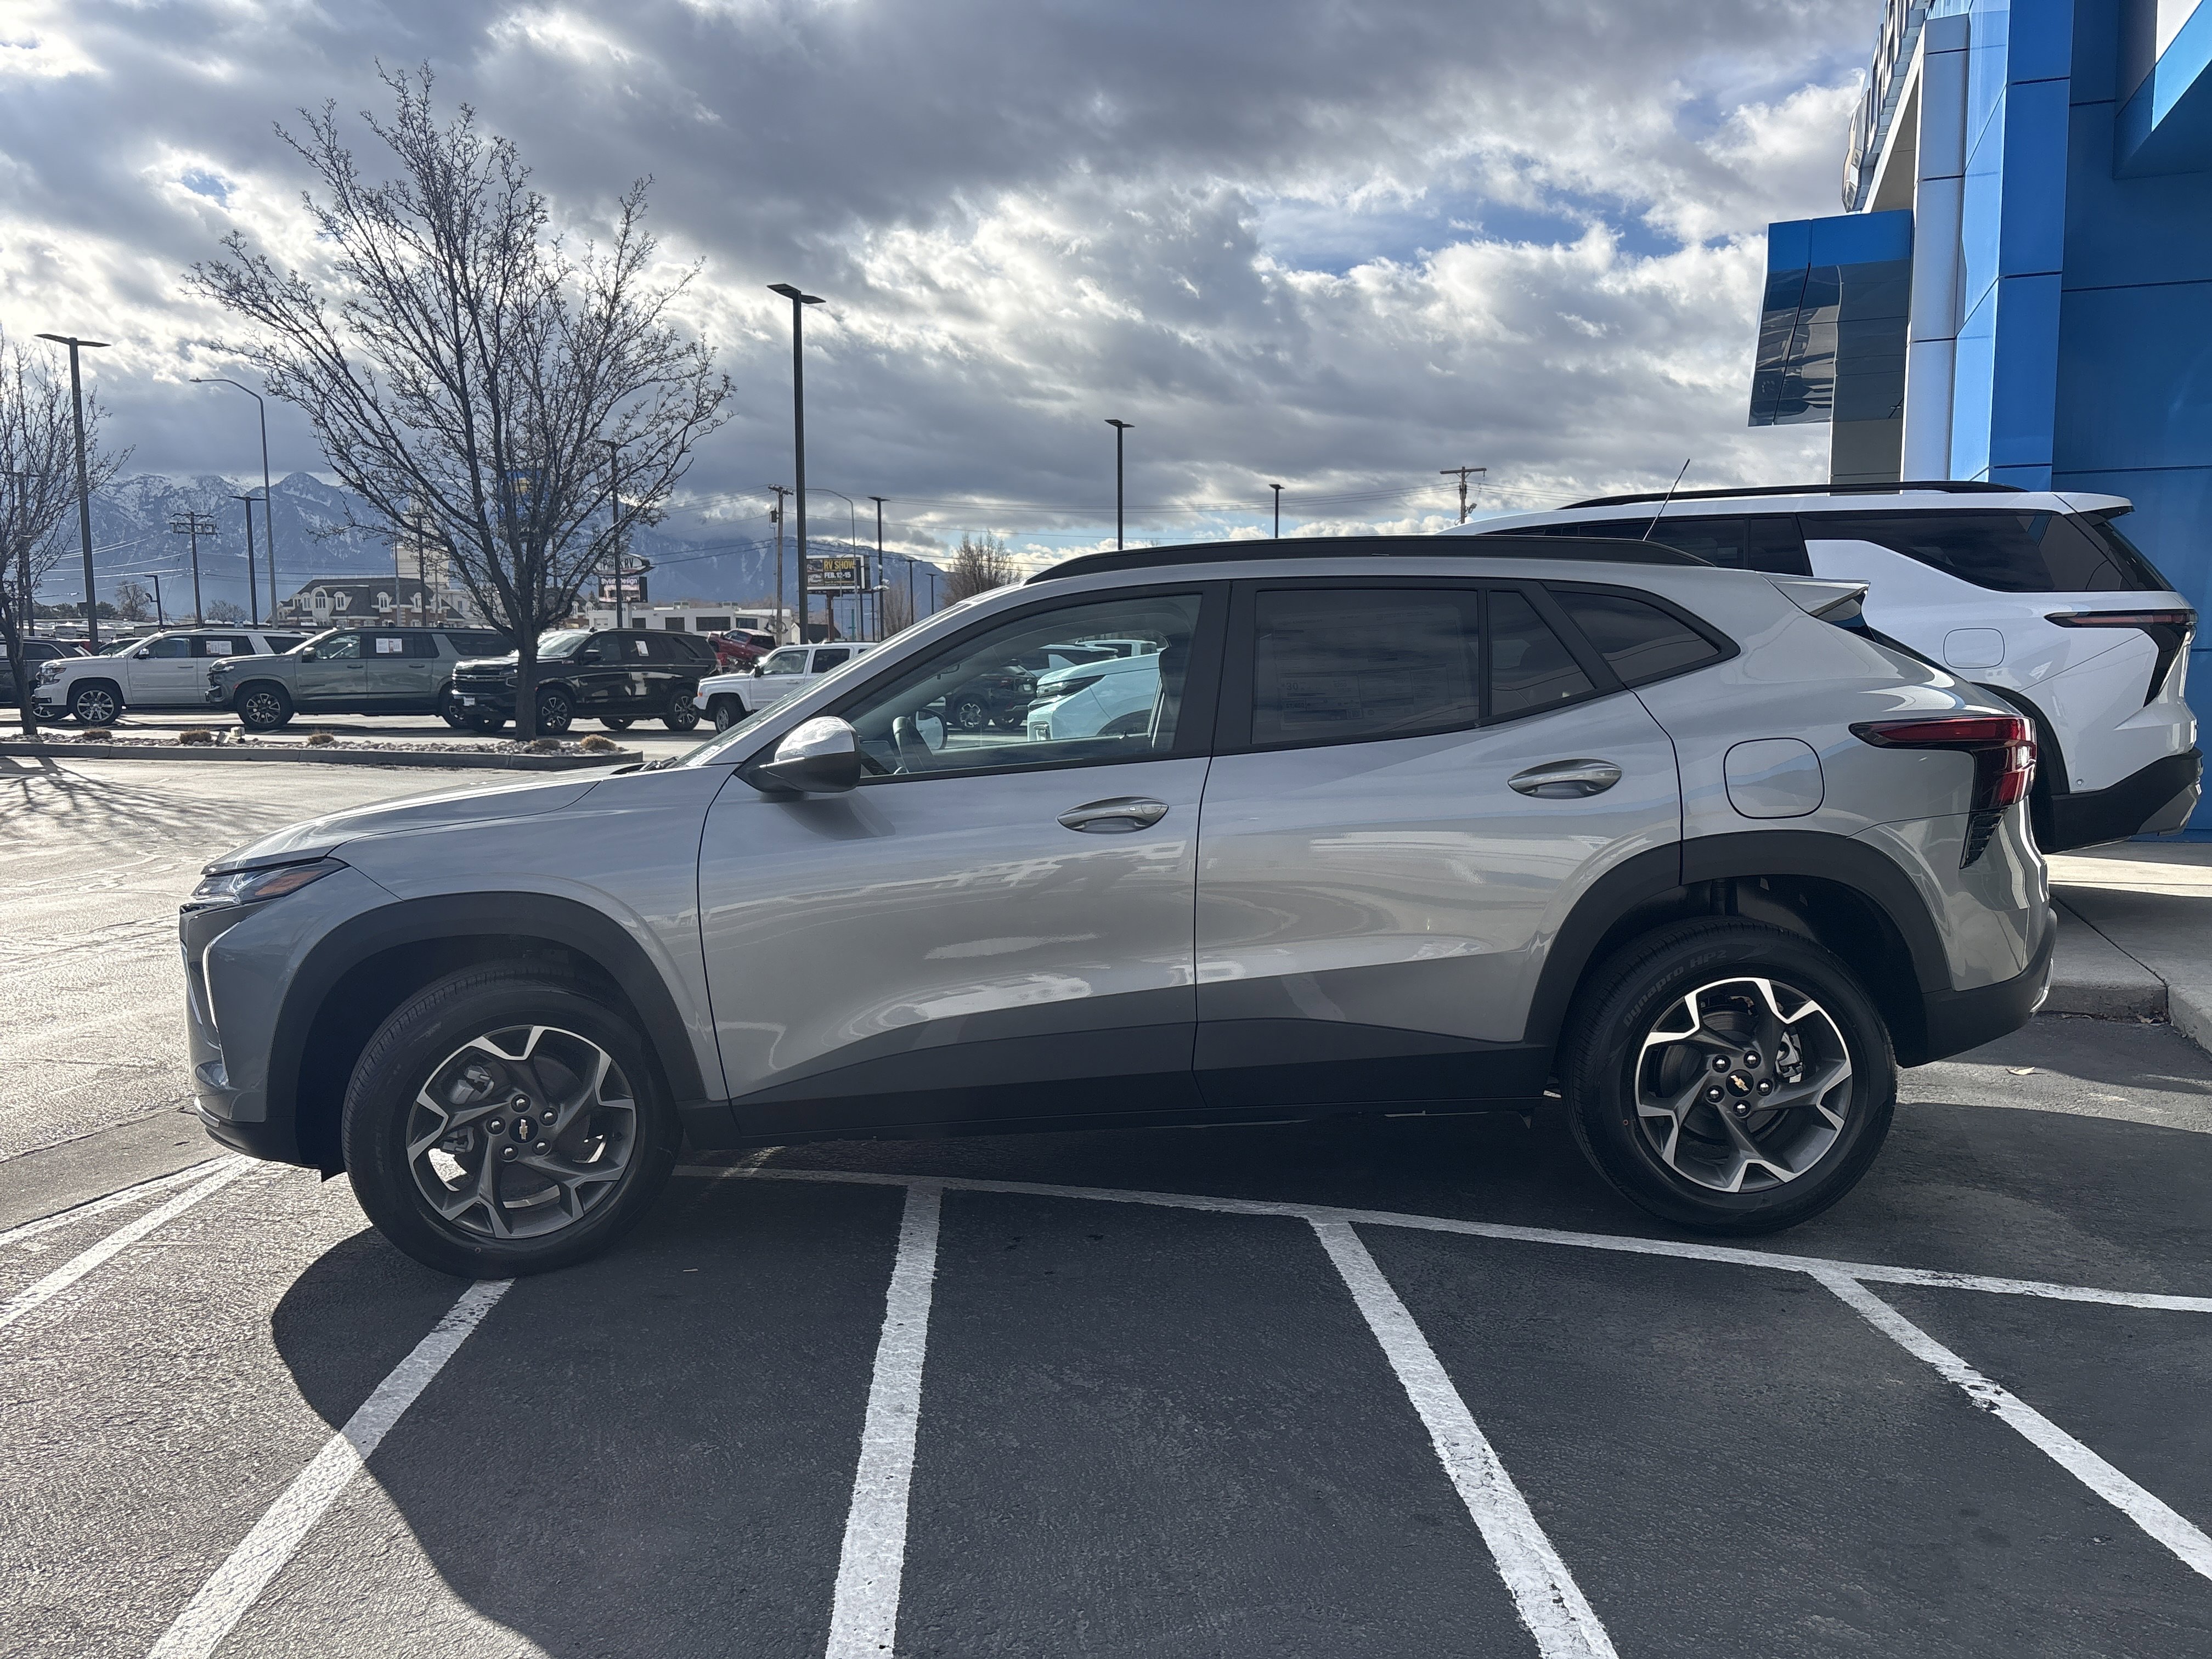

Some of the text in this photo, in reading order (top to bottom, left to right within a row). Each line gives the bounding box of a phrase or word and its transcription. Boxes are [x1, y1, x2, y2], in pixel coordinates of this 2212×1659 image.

[624, 558, 634, 569] RV
[824, 560, 855, 569] RV SHOW
[1623, 950, 1727, 1028] Dynapro HP2
